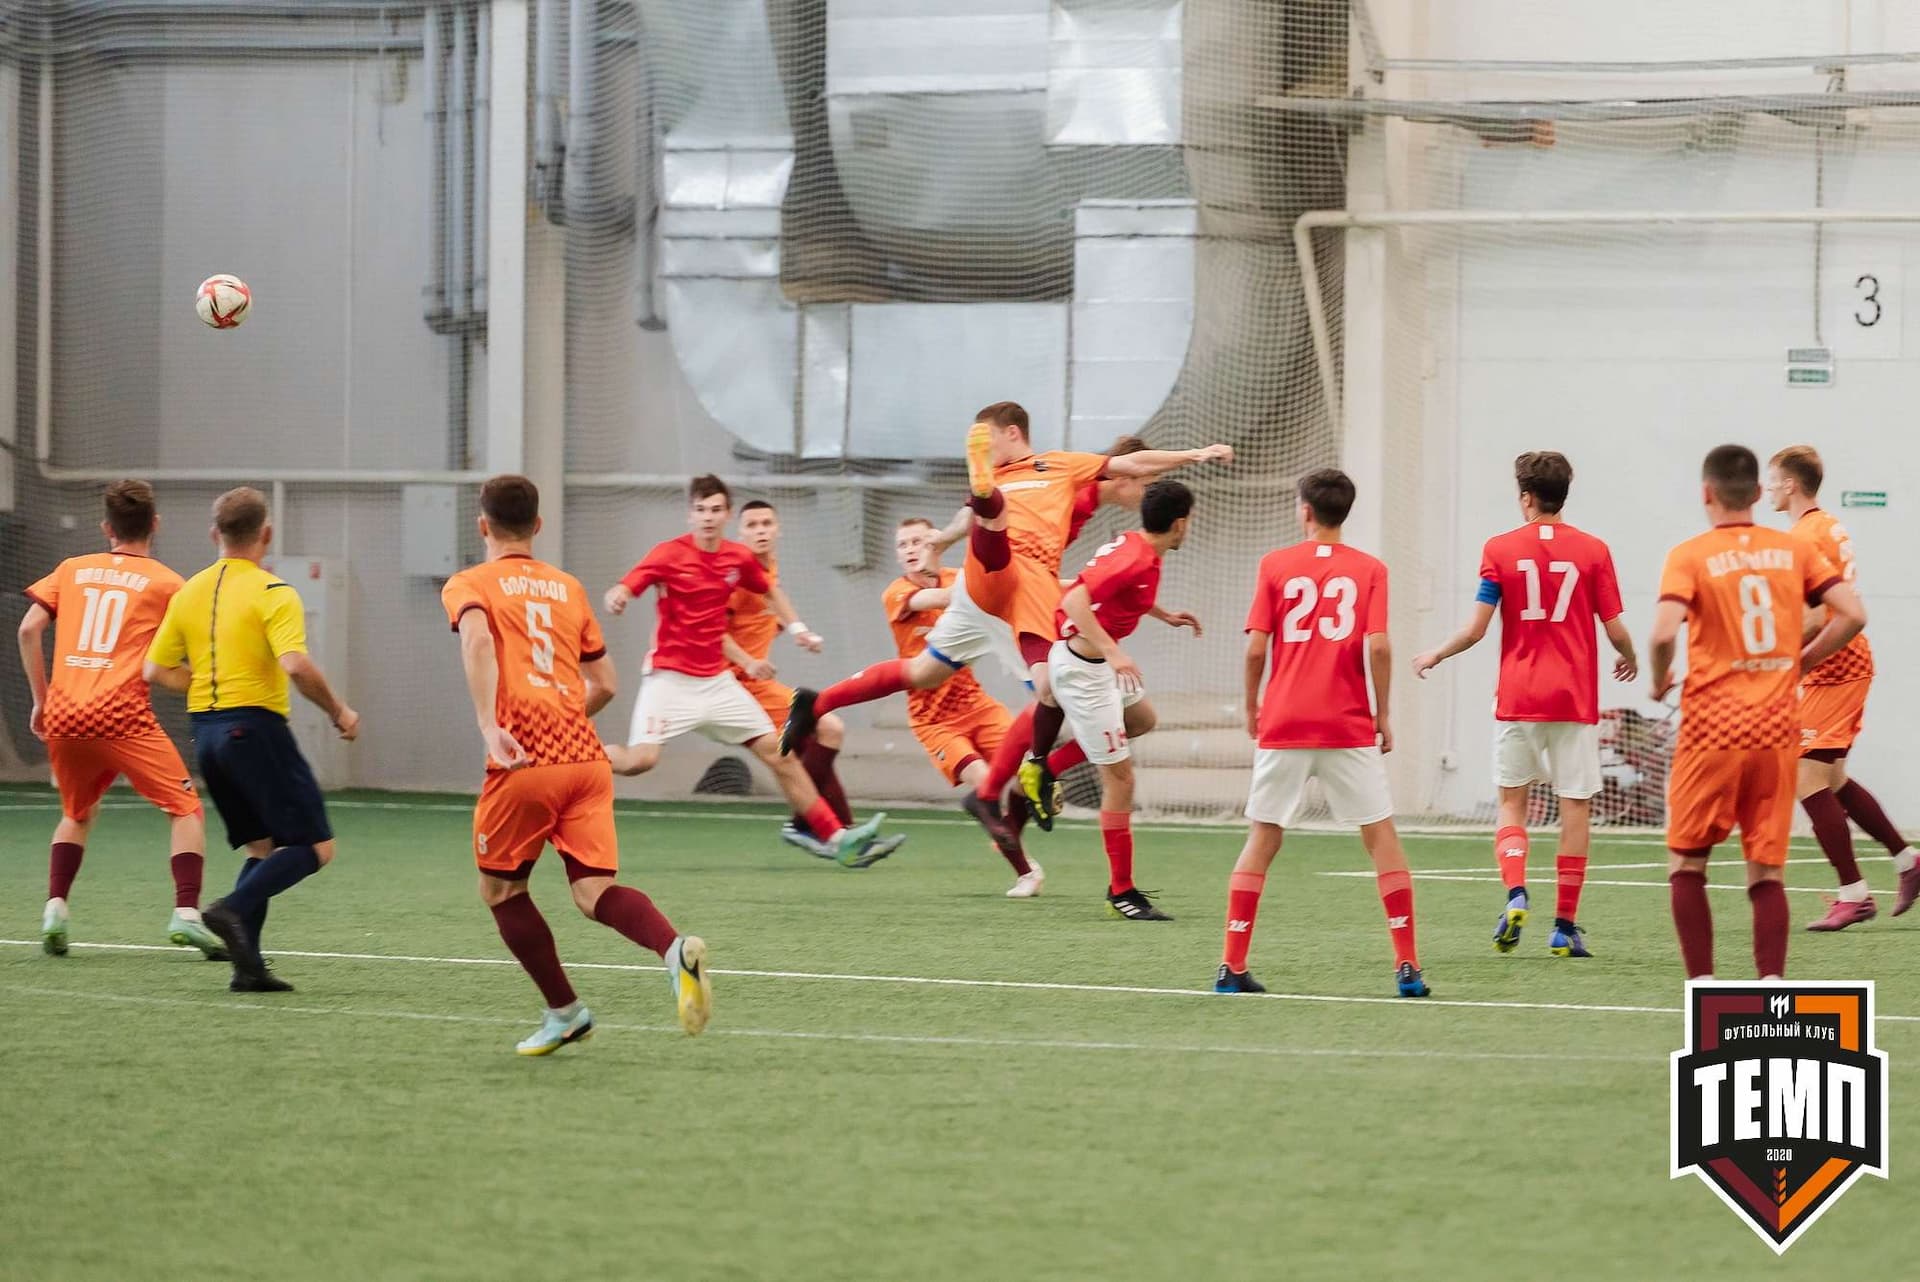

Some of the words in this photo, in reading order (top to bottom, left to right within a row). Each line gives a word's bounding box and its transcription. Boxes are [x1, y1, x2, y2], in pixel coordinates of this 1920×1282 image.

[1854, 276, 1881, 327] 3
[77, 587, 129, 654] 10
[1283, 575, 1358, 642] 23
[1517, 559, 1580, 622] 17
[1739, 574, 1776, 655] 8
[525, 600, 555, 675] 5
